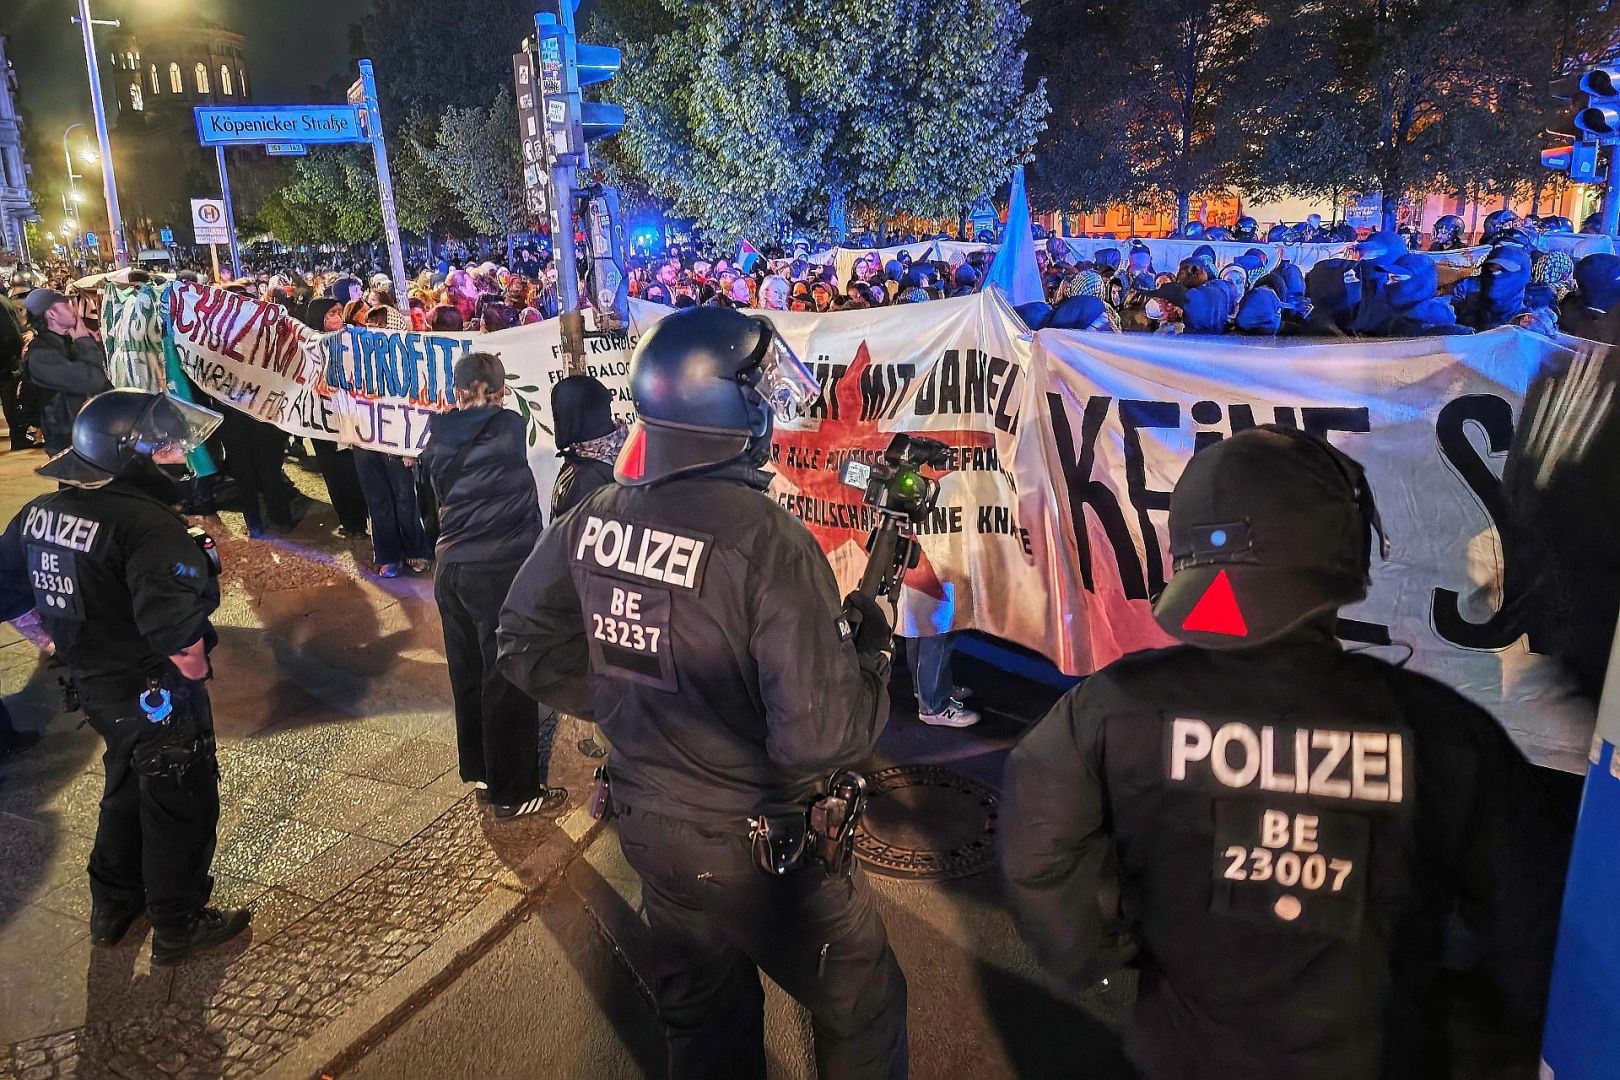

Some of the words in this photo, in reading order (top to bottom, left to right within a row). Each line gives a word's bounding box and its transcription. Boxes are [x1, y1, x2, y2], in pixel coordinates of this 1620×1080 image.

[210, 114, 298, 136] Köpenicker
[301, 113, 349, 134] Straße
[287, 388, 341, 434] ALLE
[860, 363, 915, 422] MIT
[355, 399, 433, 450] JETZ
[22, 505, 100, 553] POLIZEI
[576, 515, 705, 589] POLIZEI
[32, 570, 74, 595] 23310
[40, 551, 60, 573] BE
[610, 586, 642, 621] BE
[592, 613, 661, 653] 23237
[1170, 716, 1403, 803] POLIZEI
[1261, 808, 1320, 853] BE
[1222, 845, 1353, 892] 23007
